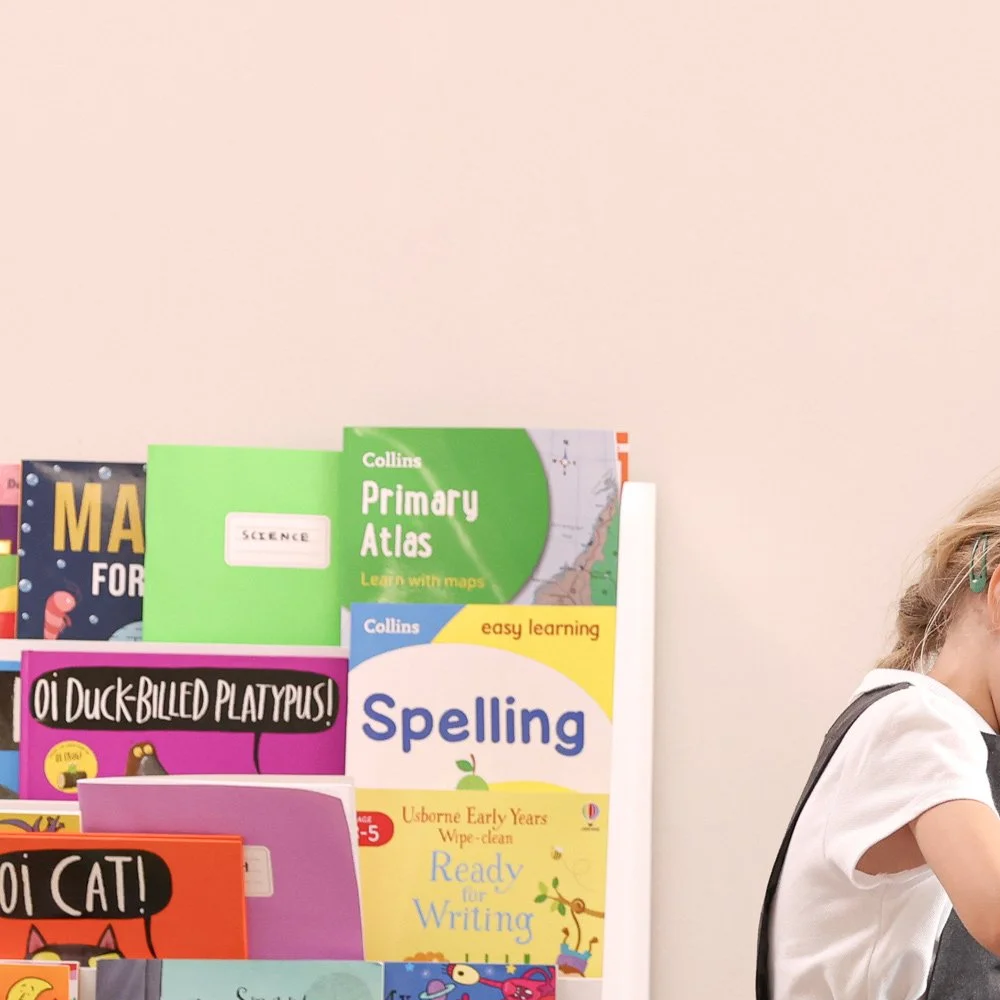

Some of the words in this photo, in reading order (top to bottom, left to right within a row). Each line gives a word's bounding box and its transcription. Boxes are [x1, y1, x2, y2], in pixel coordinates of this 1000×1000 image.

[362, 451, 422, 469] Collins
[361, 480, 479, 522] Primary
[242, 529, 310, 542] SCIENCE
[360, 522, 433, 558] Atlas
[91, 562, 144, 597] FOR
[361, 572, 404, 587] Learn
[408, 573, 440, 588] with
[444, 576, 485, 592] maps
[363, 619, 420, 634] Collins
[481, 622, 522, 640] easy
[528, 619, 600, 640] learning
[215, 678, 335, 727] PLATYPUS!
[362, 693, 585, 757] Spelling
[402, 806, 461, 824] Usborne
[467, 806, 507, 831] Early
[510, 808, 548, 825] Years
[50, 855, 146, 916] CAT!
[430, 849, 524, 894] Ready
[462, 885, 487, 903] for
[412, 898, 535, 945] Writing
